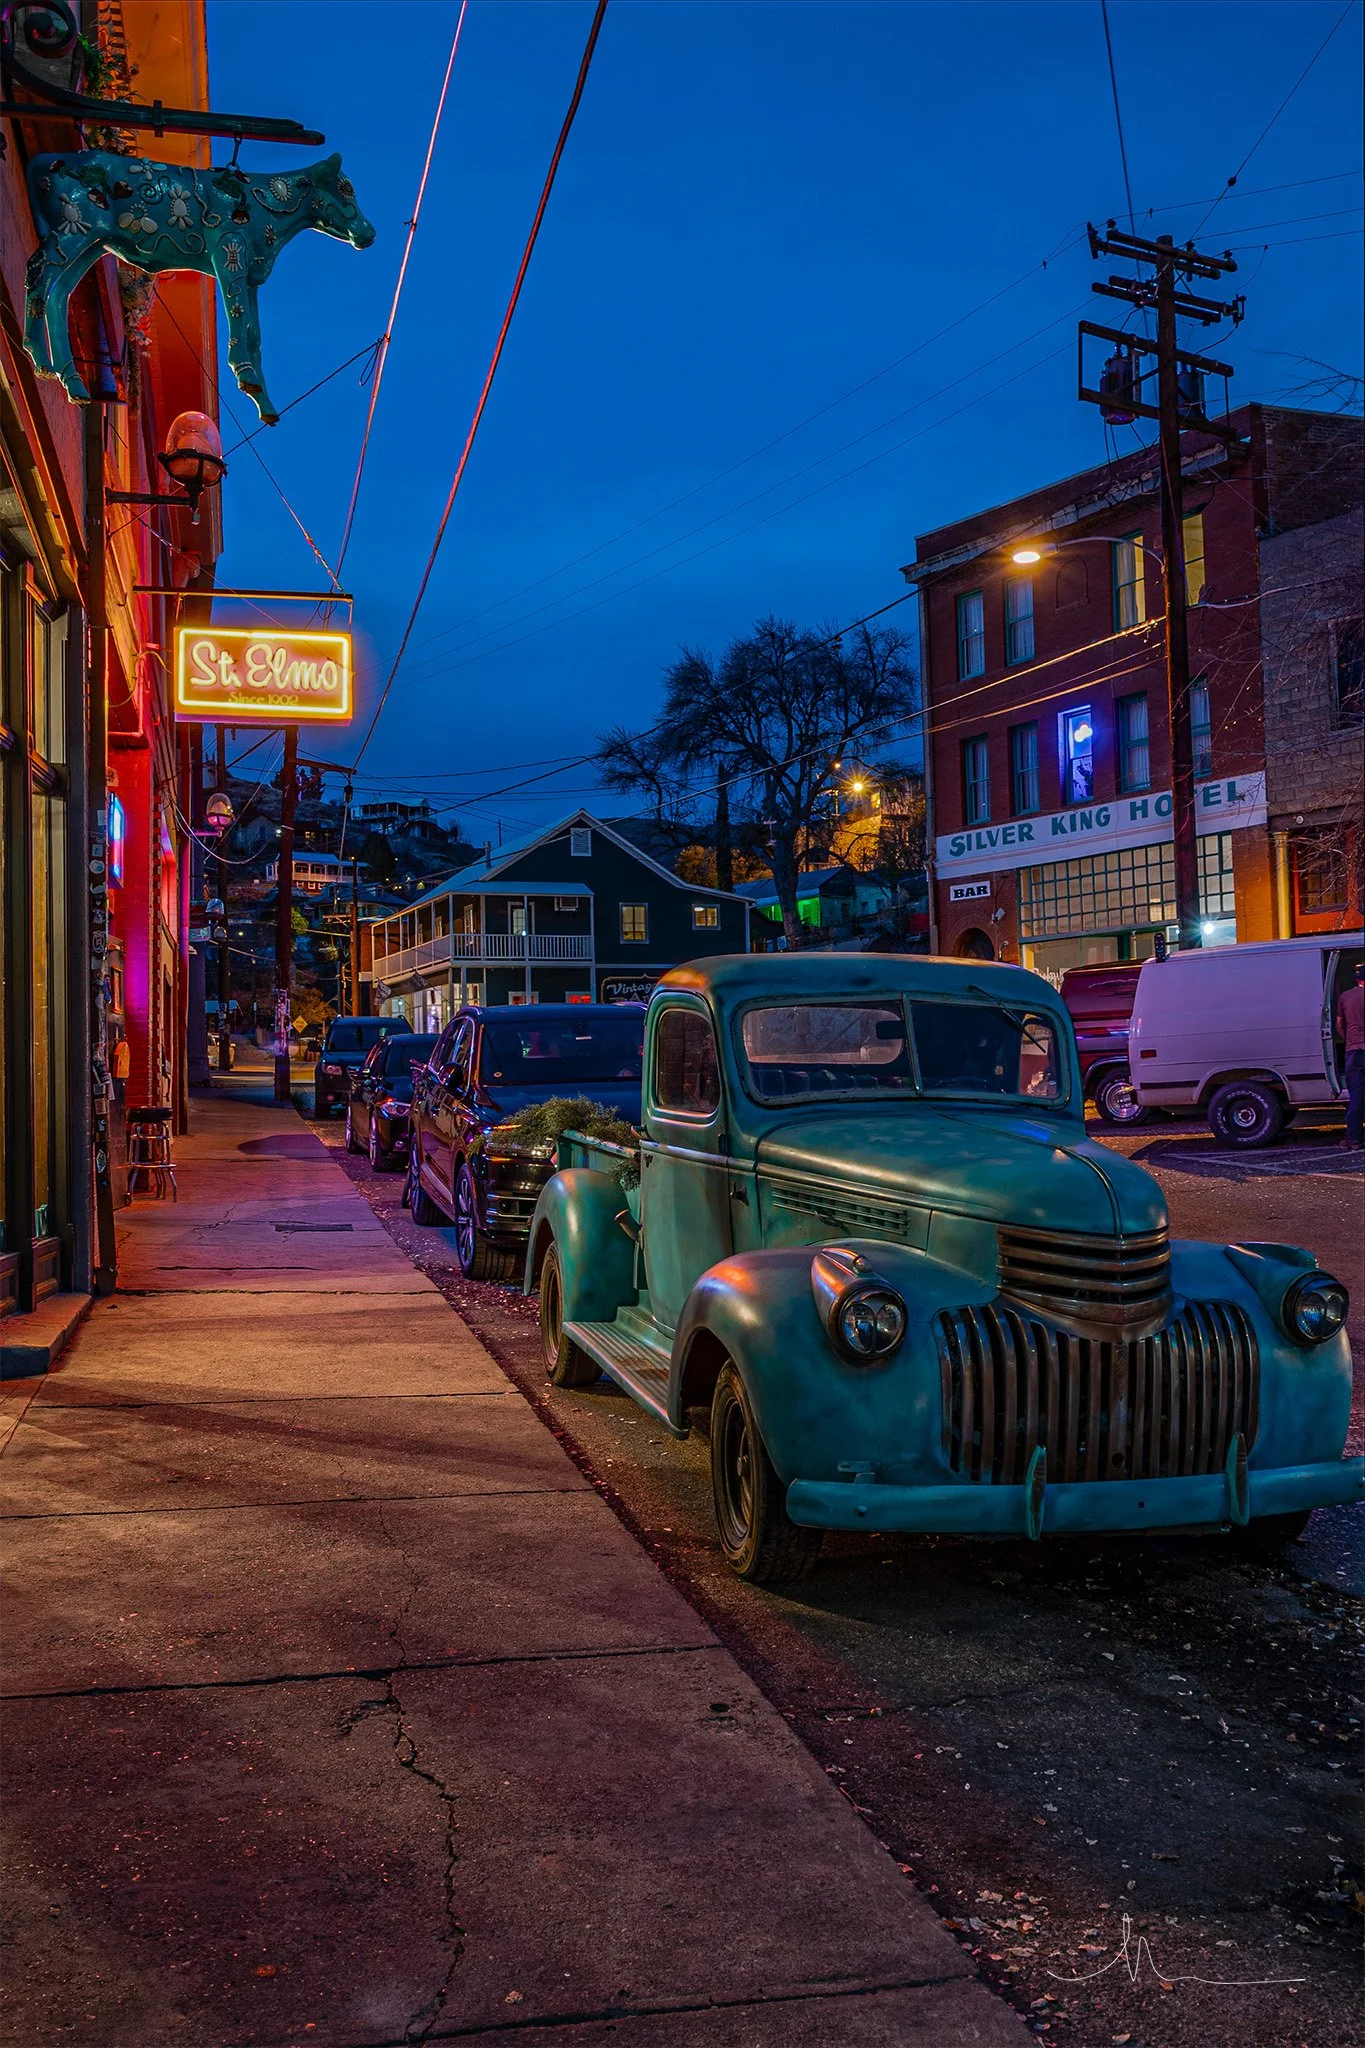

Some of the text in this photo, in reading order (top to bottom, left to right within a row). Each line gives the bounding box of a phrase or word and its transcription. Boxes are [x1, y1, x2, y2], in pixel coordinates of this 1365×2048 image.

[190, 641, 339, 691] St. Elmo
[228, 692, 299, 706] Since 1902
[949, 781, 1241, 857] SILVER KING HOEL
[953, 884, 989, 899] BAR
